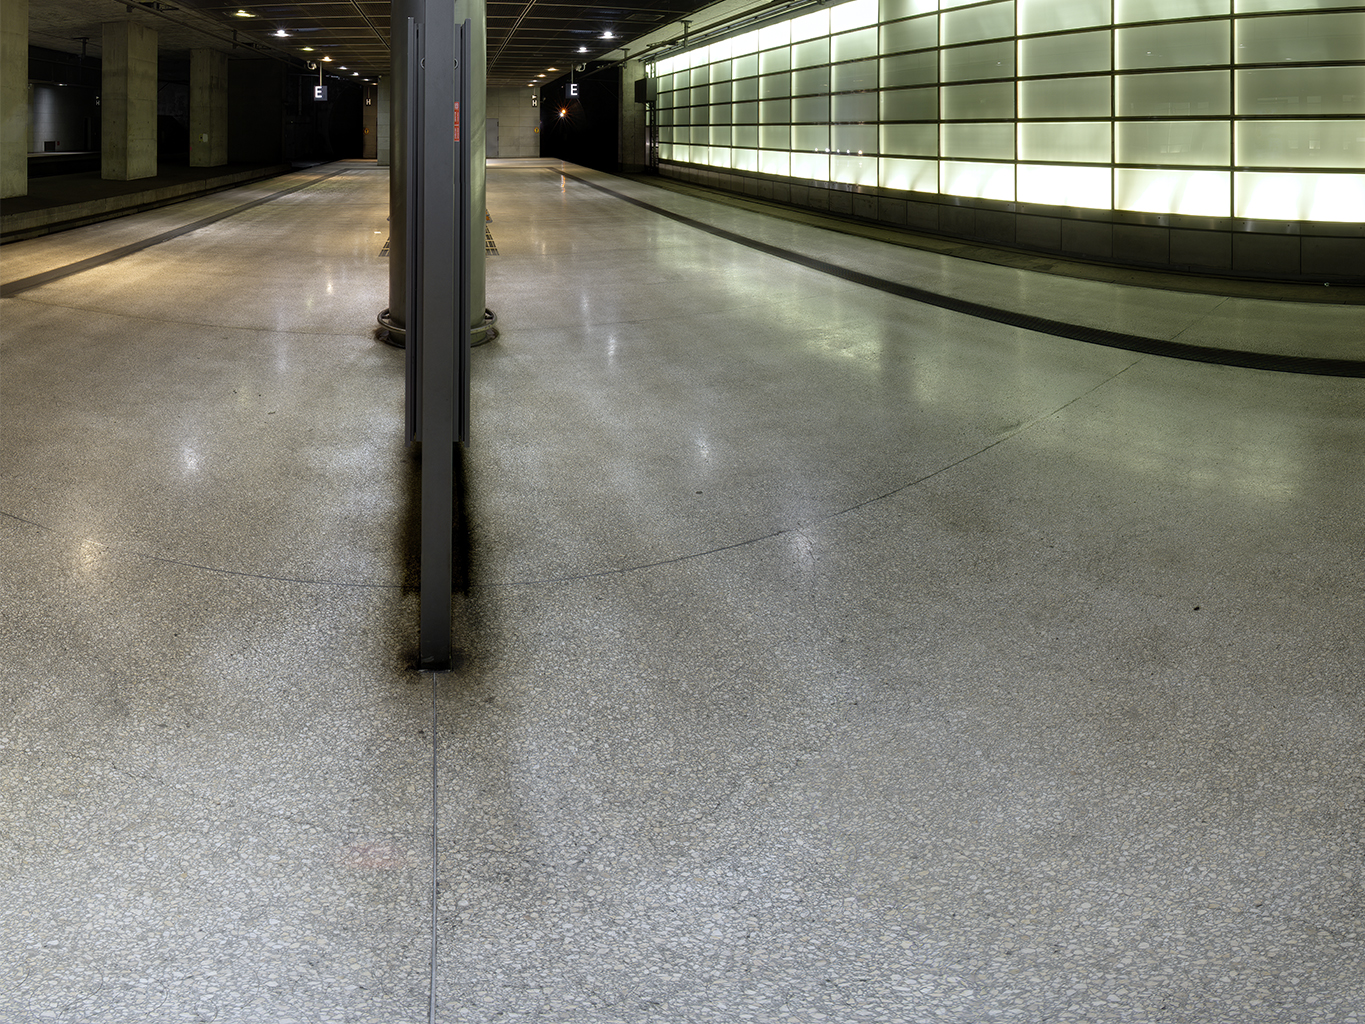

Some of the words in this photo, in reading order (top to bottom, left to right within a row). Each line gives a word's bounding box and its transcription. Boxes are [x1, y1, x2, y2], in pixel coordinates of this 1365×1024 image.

[314, 86, 323, 98] E
[570, 83, 578, 96] E
[365, 98, 372, 106] H
[532, 99, 538, 107] H
